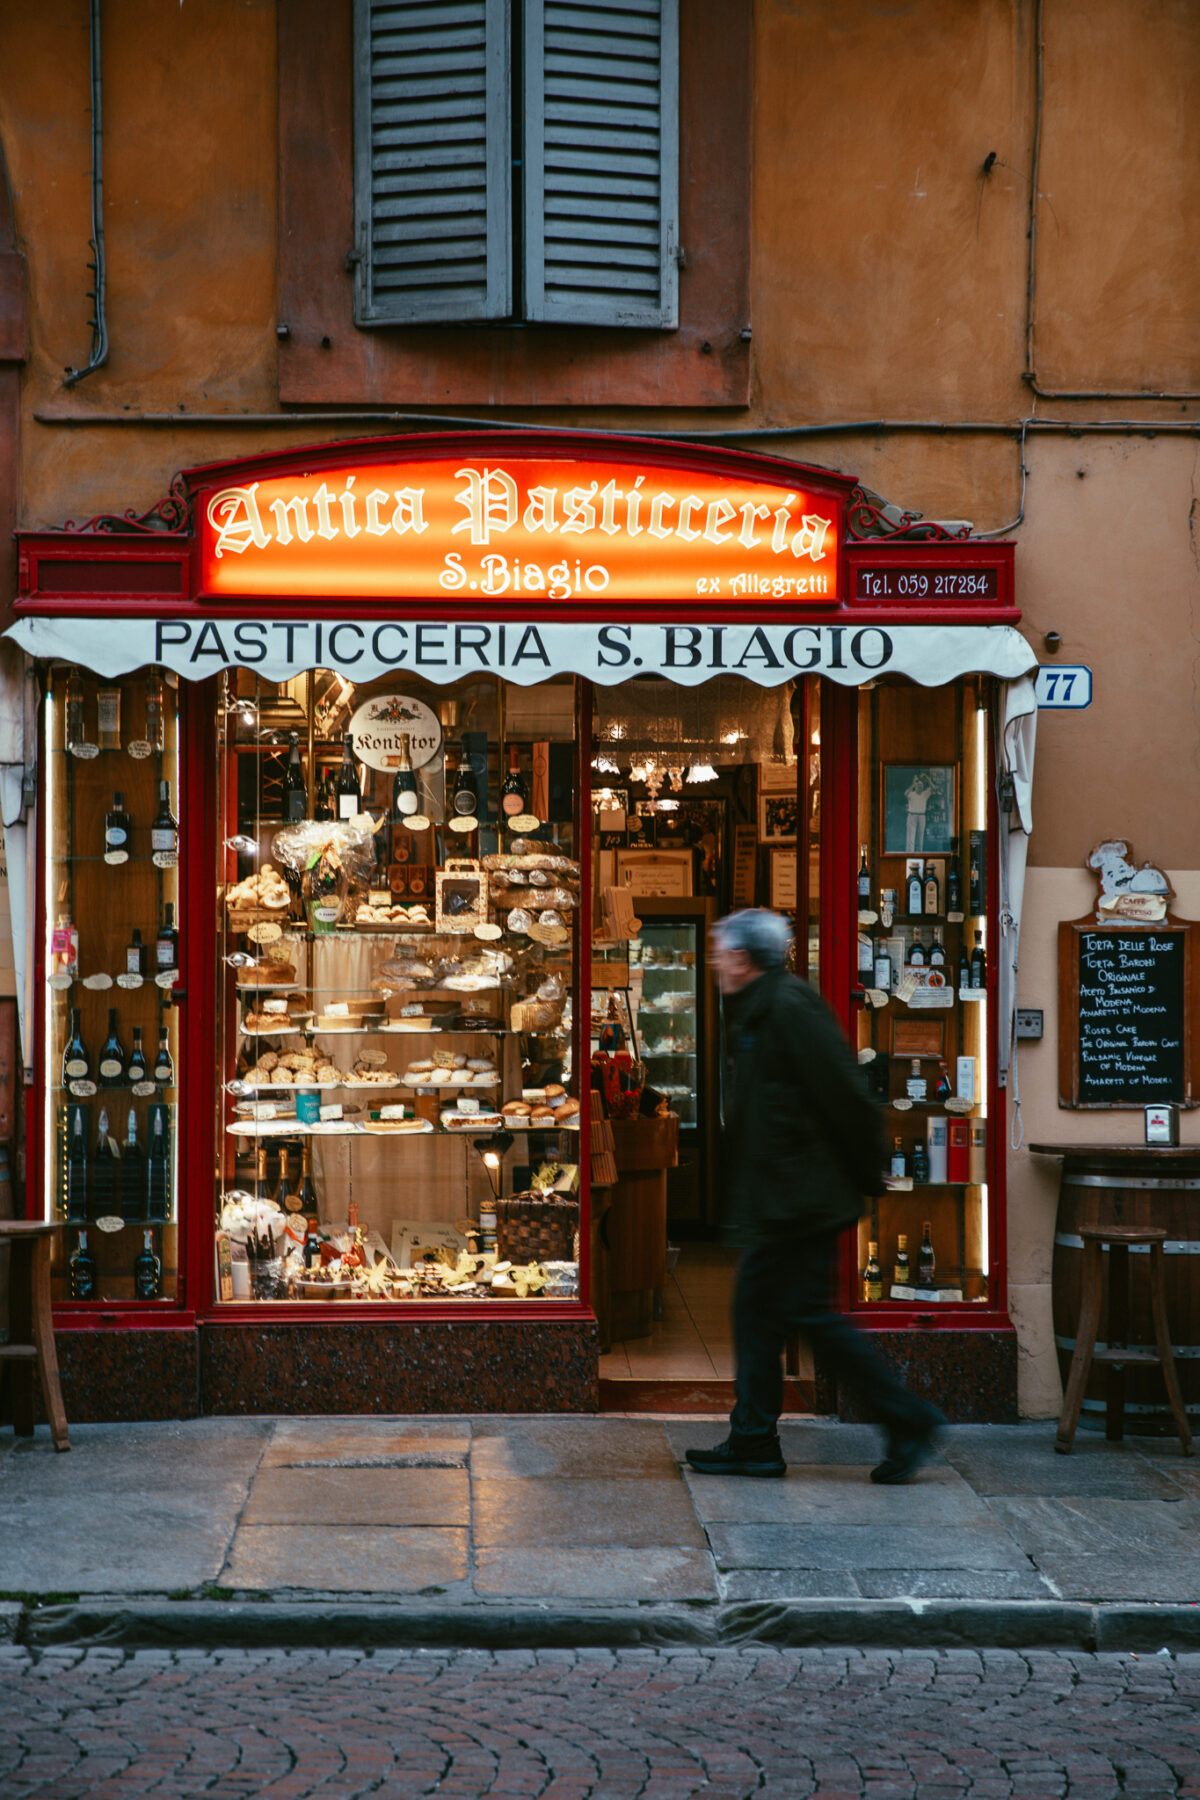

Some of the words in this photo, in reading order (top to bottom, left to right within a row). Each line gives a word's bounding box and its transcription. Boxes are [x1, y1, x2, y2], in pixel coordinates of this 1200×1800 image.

[207, 476, 429, 558] Antica
[451, 468, 832, 562] Pasticceria
[696, 577, 720, 594] ex
[729, 573, 828, 597] Allegretti
[862, 573, 892, 596] Tel.
[898, 574, 928, 597] 059
[934, 575, 988, 594] 217284
[155, 621, 551, 667] PASTICCERIA
[597, 626, 643, 667] S.
[660, 626, 893, 669] BIAGIO
[1046, 674, 1077, 701] 77
[355, 733, 436, 750] Kondtor
[1082, 934, 1114, 950] TORTA
[1118, 940, 1145, 951] DELLE
[1148, 937, 1175, 952] ROSE
[1082, 952, 1115, 968] TORTA
[1080, 984, 1106, 996] ACETO
[1095, 996, 1132, 1007] MODENA
[1116, 1024, 1137, 1034] CAKE
